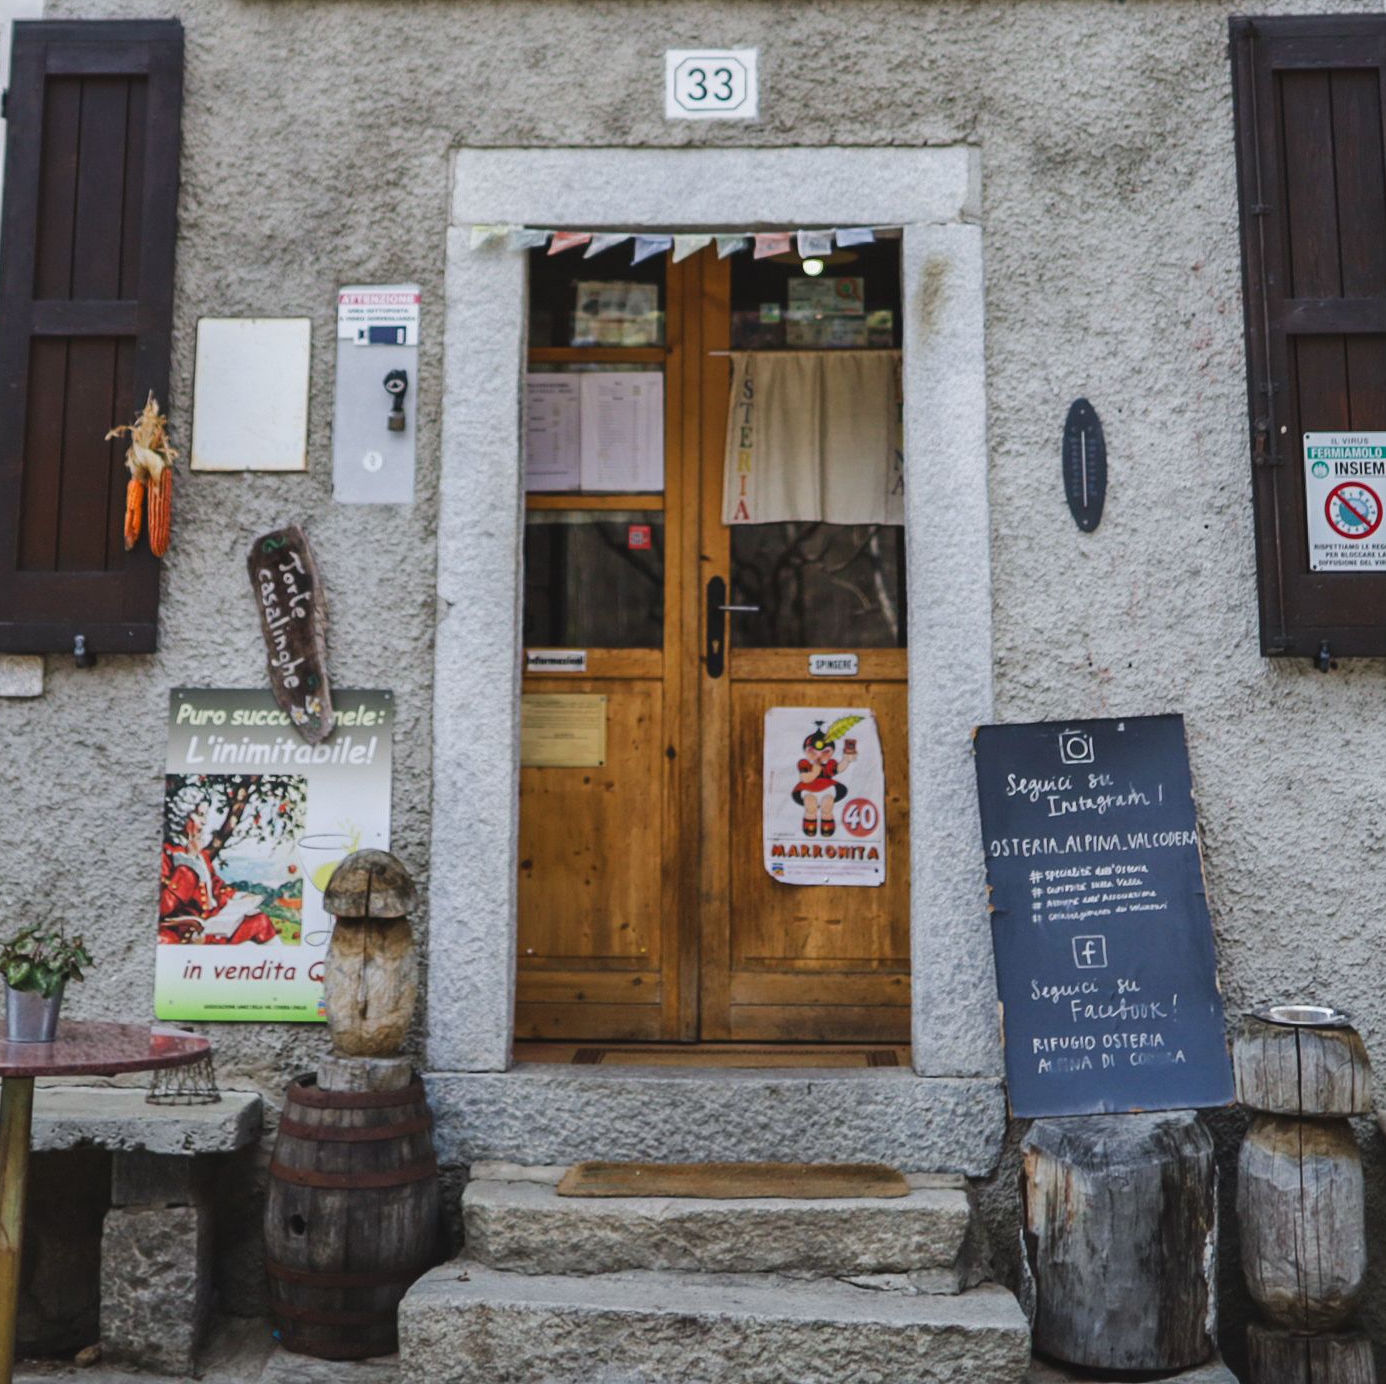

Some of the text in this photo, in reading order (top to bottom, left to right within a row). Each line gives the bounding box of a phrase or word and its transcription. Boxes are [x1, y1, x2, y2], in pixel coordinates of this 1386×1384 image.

[685, 65, 735, 104] 33
[340, 293, 416, 305] ATTENZIONE
[1331, 437, 1369, 445] IL VIRUS
[278, 551, 312, 619] Torte
[258, 568, 305, 690] casalinghe
[815, 659, 853, 670] SPINGERE
[176, 703, 227, 727] Puro
[185, 735, 379, 765] L'inimitabile!
[1006, 773, 1114, 803] Seguici su
[845, 804, 877, 830] 40
[770, 844, 879, 861] MARRONITA
[182, 959, 202, 980] in
[214, 959, 297, 981] vendita
[1031, 977, 1141, 1004] Seguici su
[1033, 1032, 1165, 1054] RIFUGIO OSTERIA
[1101, 1053, 1115, 1069] DI
